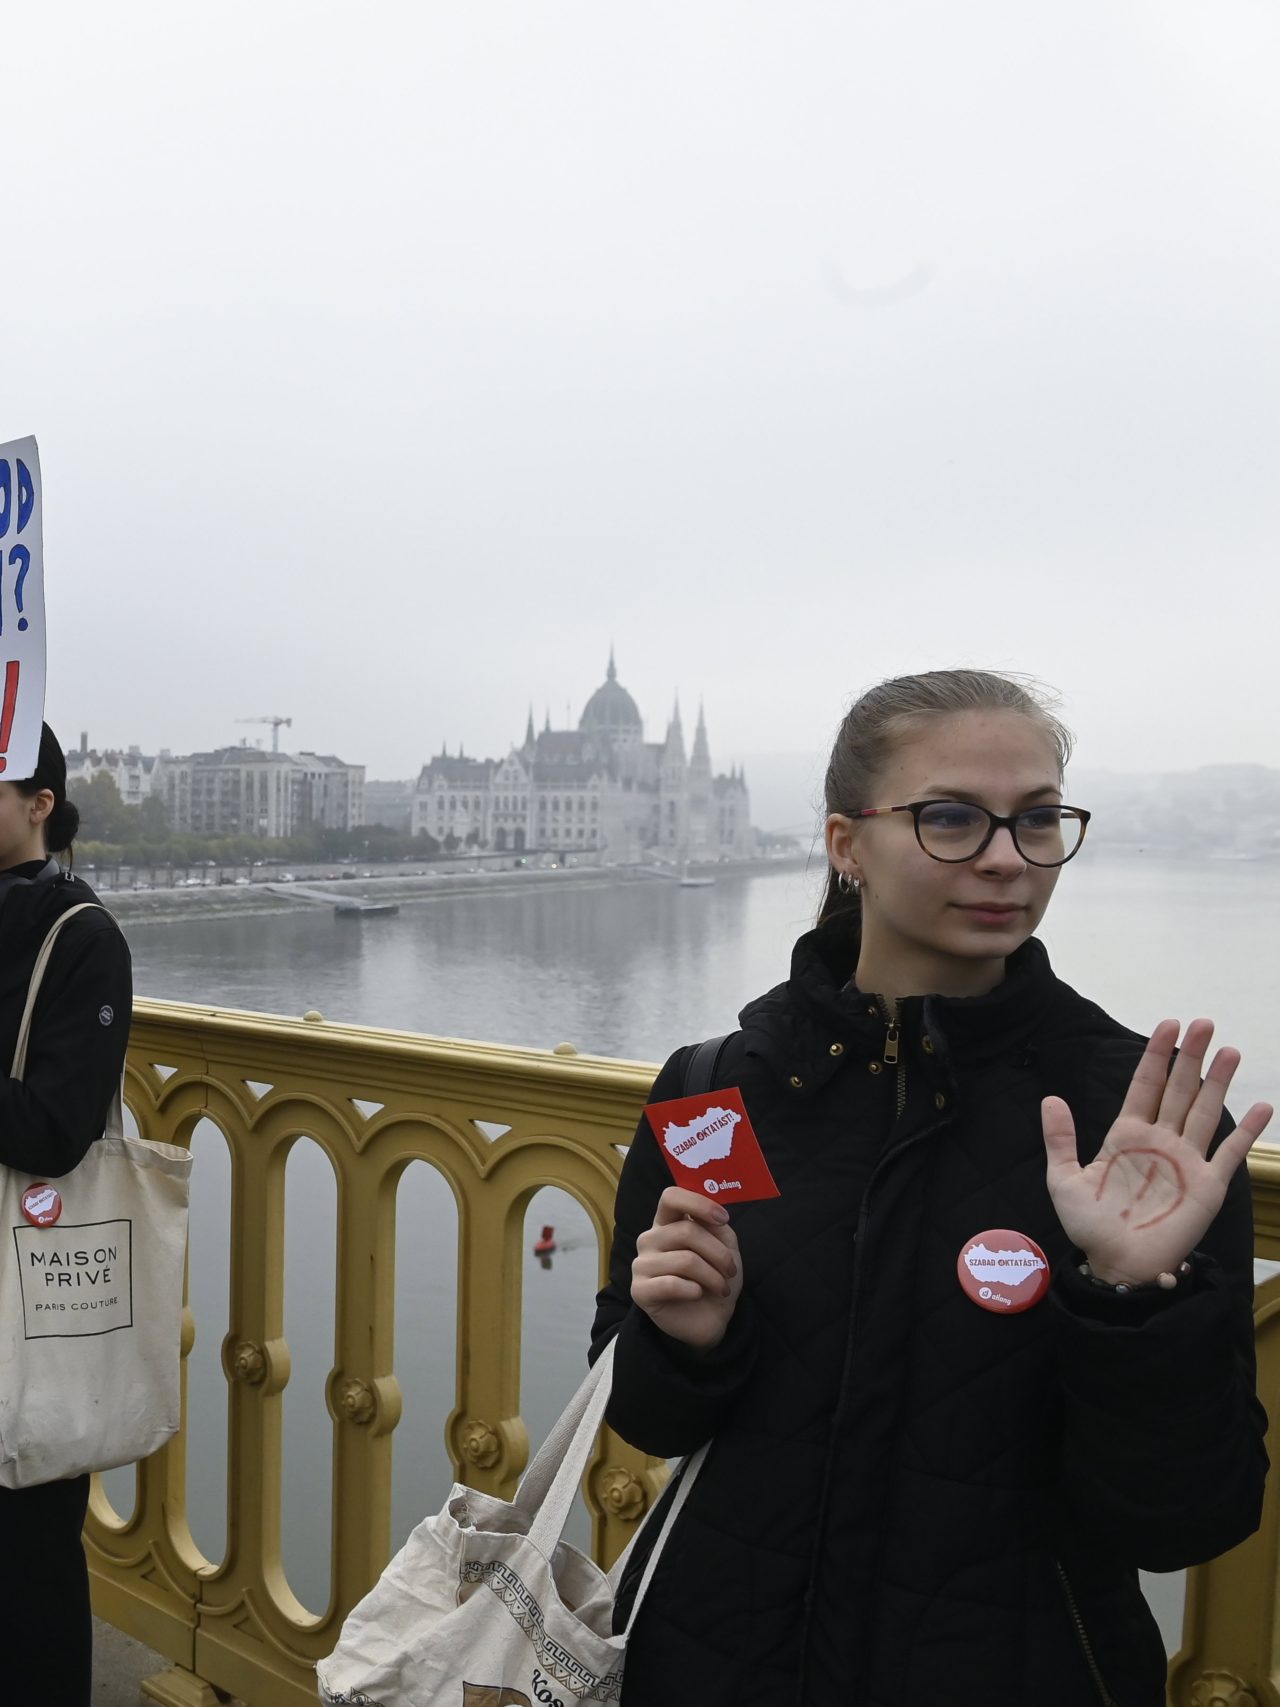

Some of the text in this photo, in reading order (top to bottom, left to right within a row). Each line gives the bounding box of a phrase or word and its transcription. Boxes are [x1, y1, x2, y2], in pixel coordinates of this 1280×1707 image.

[672, 1112, 735, 1156] SZABAD OKTATÁST!
[30, 1246, 117, 1267] MAISON
[969, 1257, 1039, 1267] SZABAD OKTATÁST!
[45, 1265, 112, 1287] PRIVÉ
[35, 1297, 118, 1312] PARIS COUTURE
